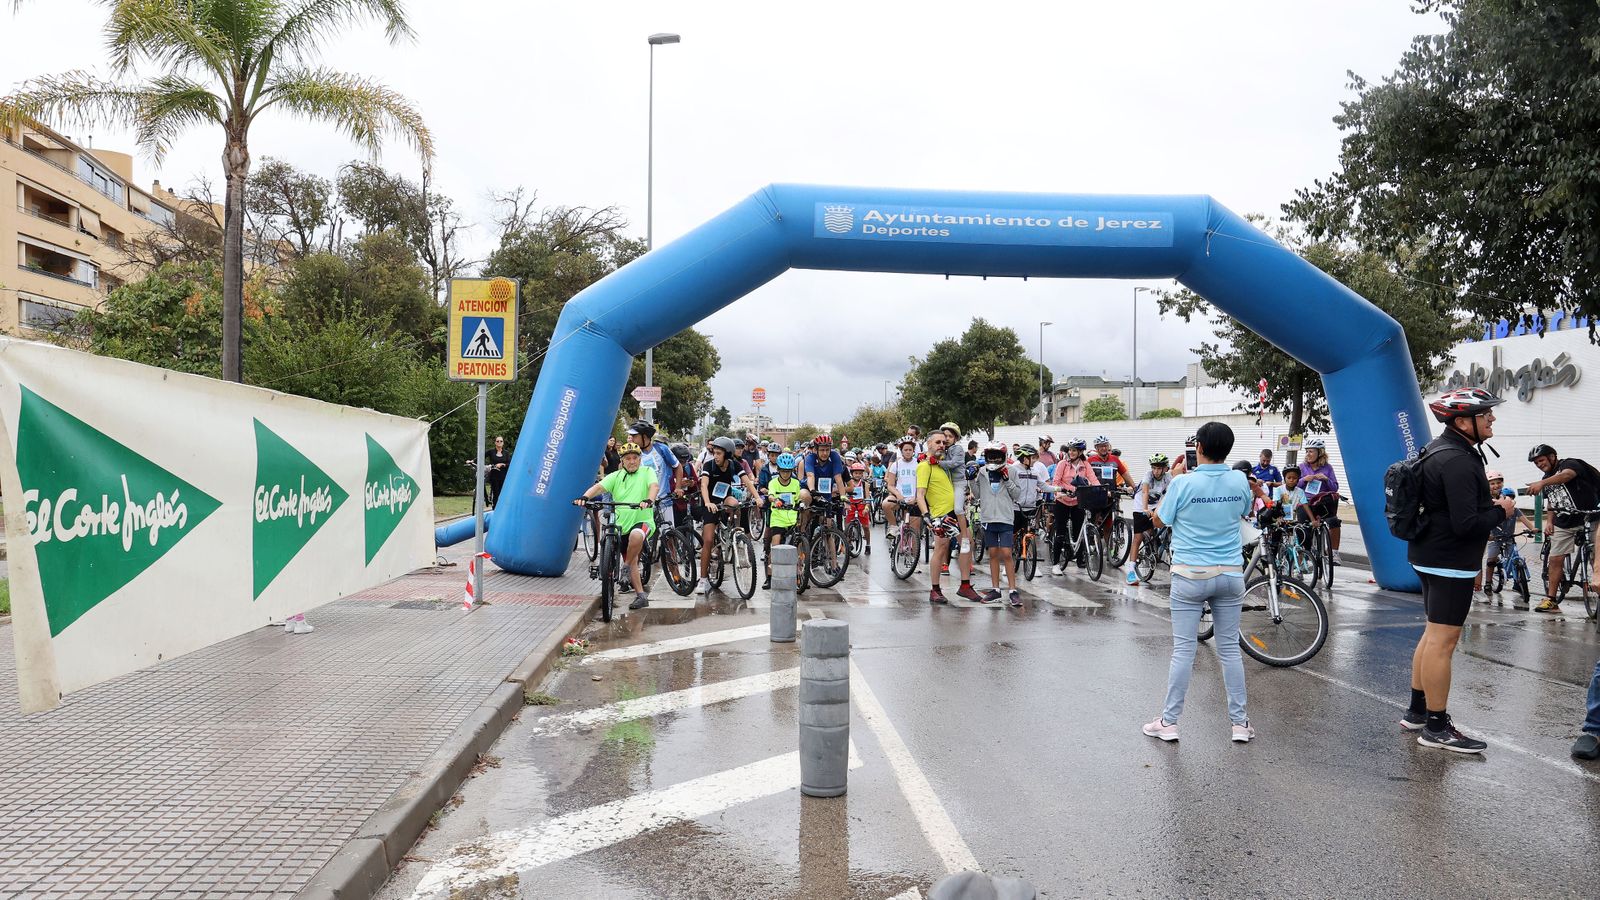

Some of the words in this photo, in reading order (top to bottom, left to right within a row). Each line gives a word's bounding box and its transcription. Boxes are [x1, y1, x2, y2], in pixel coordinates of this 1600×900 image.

[862, 223, 950, 237] Deportes
[863, 209, 1051, 227] Ayuntamiento
[1058, 216, 1089, 228] de
[1095, 216, 1162, 231] Jerez
[458, 300, 508, 312] ATENCION
[457, 362, 508, 376] PEATONES
[536, 389, 576, 495] deportes@aytojerez.es
[254, 484, 270, 523] El
[269, 484, 298, 520] Corte
[297, 474, 332, 528] Inglés
[365, 482, 373, 510] El
[373, 481, 390, 508] Corte
[389, 473, 411, 515] Inglés
[23, 488, 52, 545] El
[53, 488, 120, 542] Corte
[121, 474, 188, 552] Inglés
